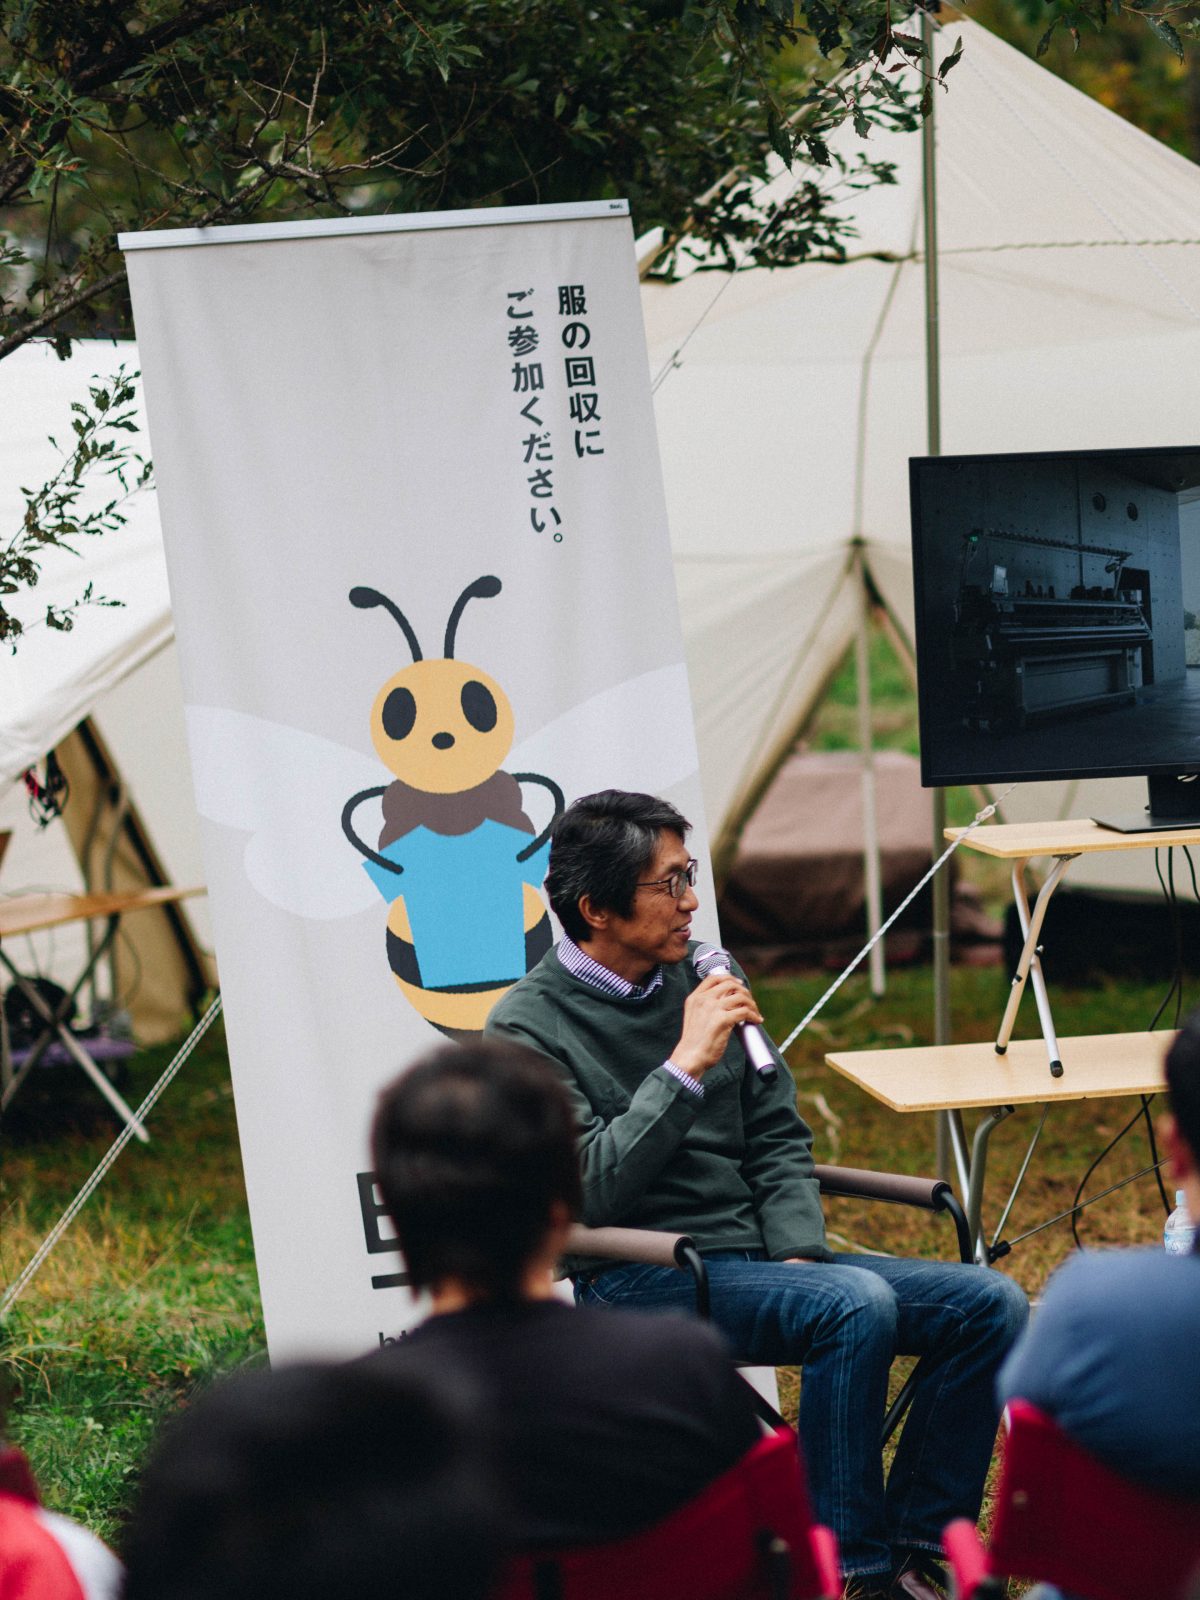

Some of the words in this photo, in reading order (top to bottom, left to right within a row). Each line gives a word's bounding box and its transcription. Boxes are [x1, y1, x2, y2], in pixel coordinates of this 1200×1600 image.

[506, 287, 563, 543] ご参加ください。
[558, 284, 605, 459] 服の回収に
